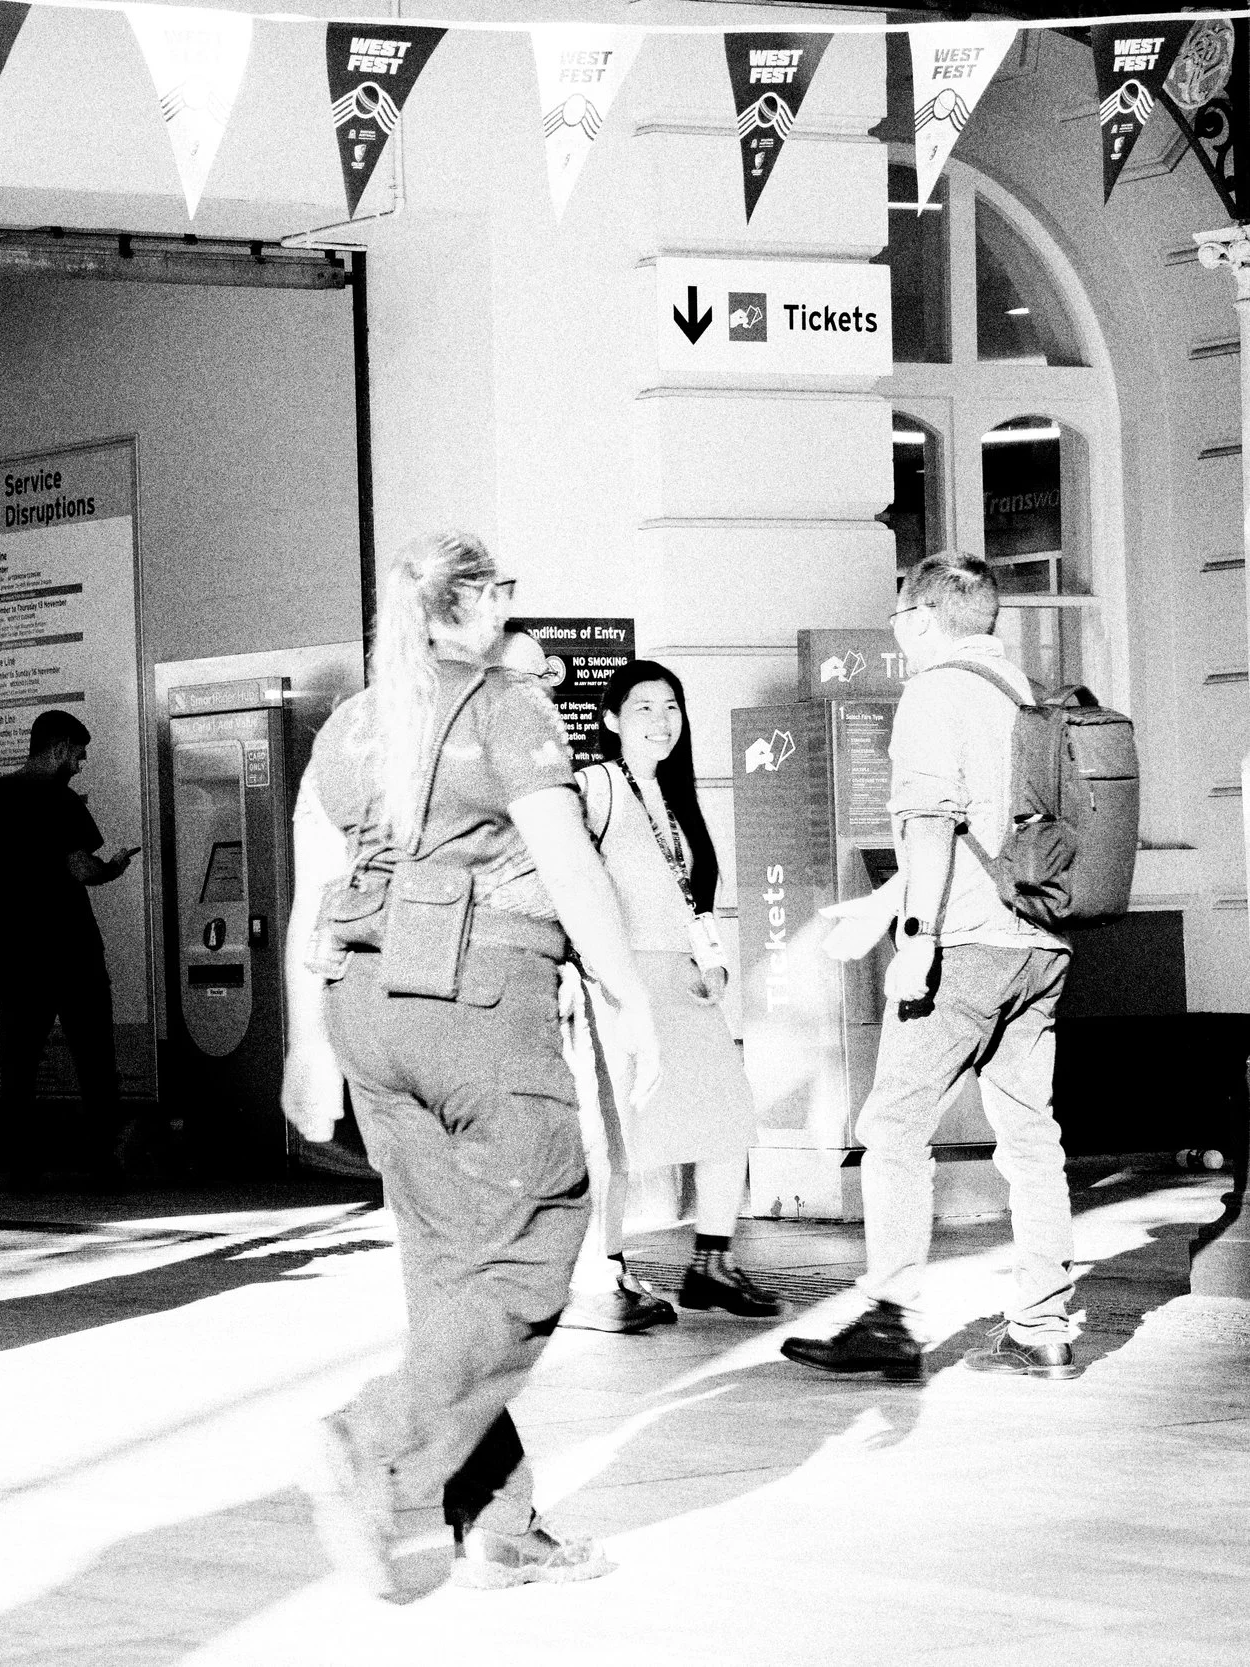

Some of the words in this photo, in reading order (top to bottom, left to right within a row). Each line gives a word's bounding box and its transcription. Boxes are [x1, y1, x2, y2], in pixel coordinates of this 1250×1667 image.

[350, 37, 412, 58] WEST
[1114, 37, 1165, 56] WEST
[559, 50, 613, 65] WEST
[749, 49, 803, 67] WEST
[934, 47, 984, 63] WEST
[1112, 54, 1159, 72] FEST
[347, 54, 403, 75] FEST
[932, 64, 977, 80] FEST
[559, 68, 605, 82] FEST
[749, 67, 798, 84] FEST
[783, 304, 878, 333] Tickets
[5, 470, 61, 496] Service
[6, 496, 95, 526] Disruptions
[44, 599, 67, 608] November
[580, 627, 591, 639] of
[594, 627, 626, 641] Entry
[572, 657, 585, 667] NO
[588, 657, 628, 667] SMOKING
[577, 669, 590, 679] NO
[560, 702, 567, 710] of
[568, 702, 597, 712] bicycles,
[579, 712, 593, 720] and
[575, 751, 590, 760] with
[249, 762, 266, 772] ONLY
[763, 864, 789, 1013] Tickets
